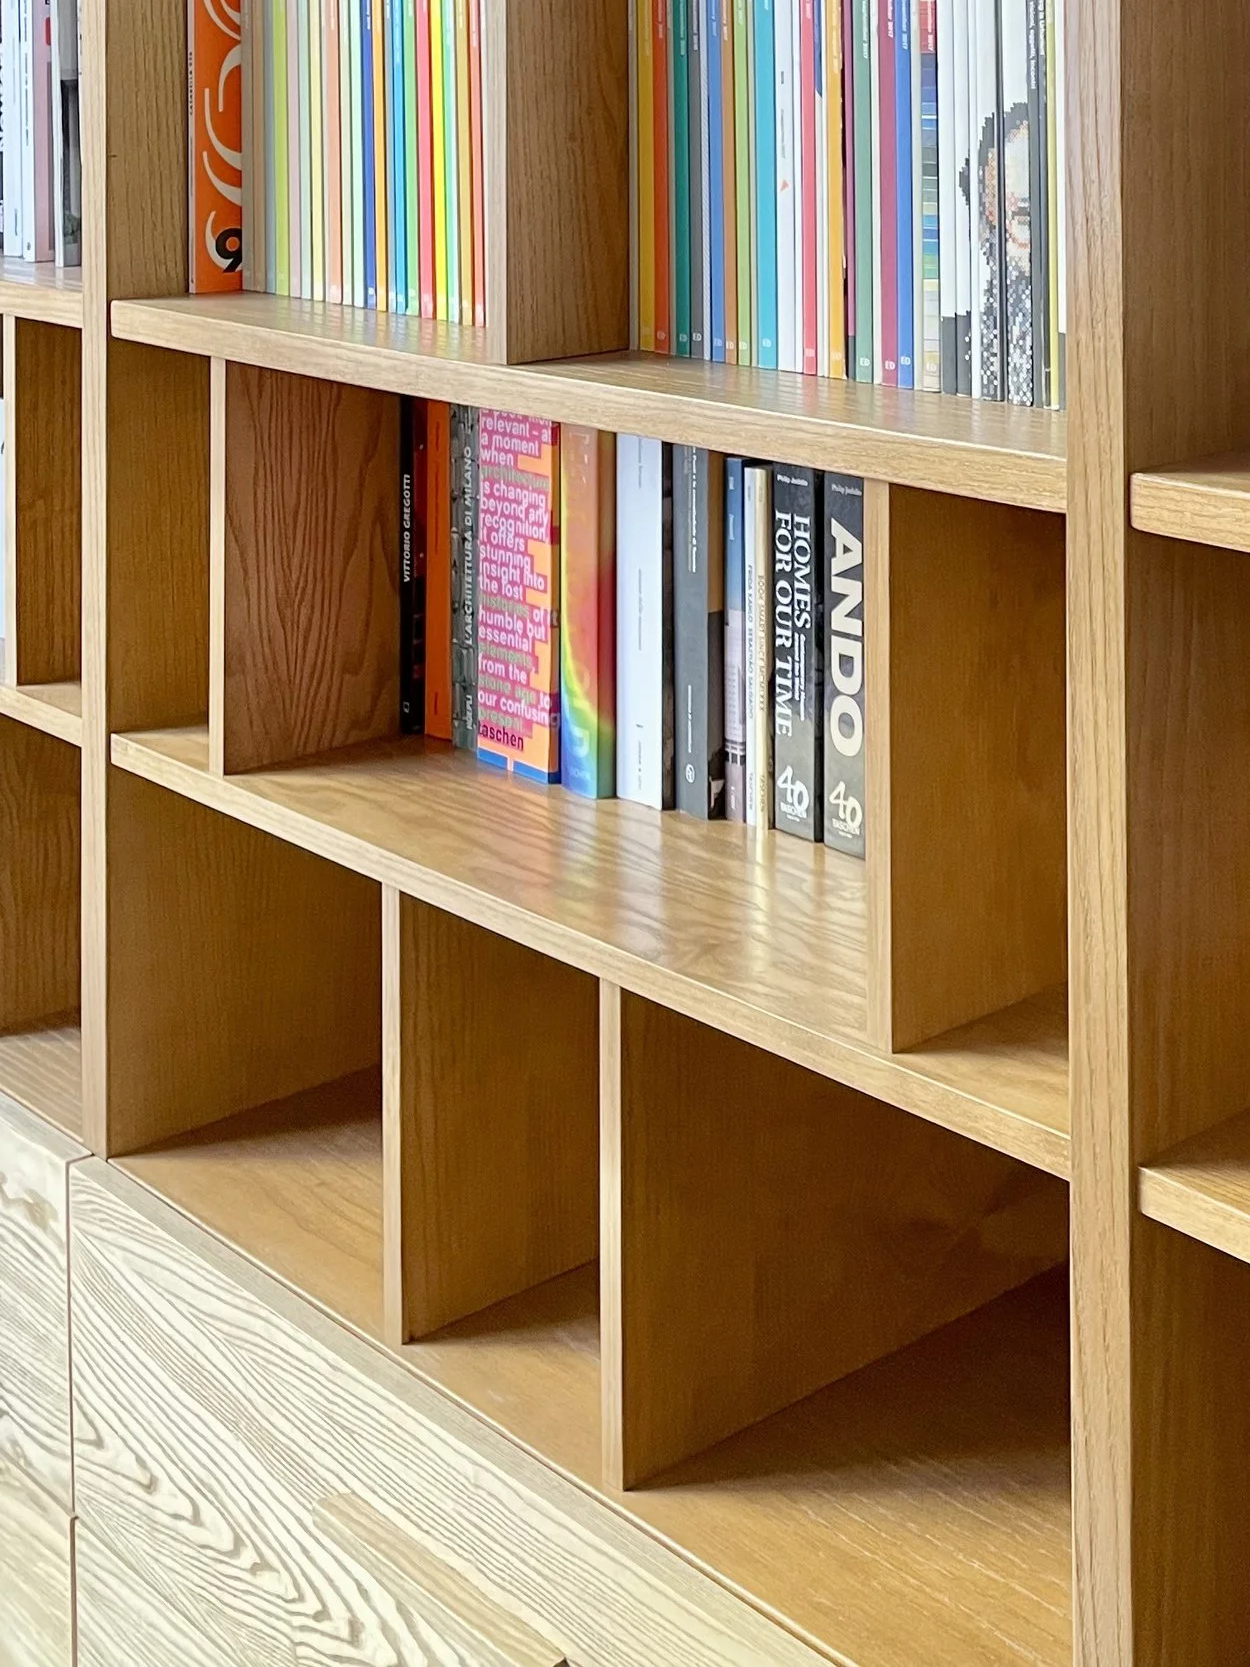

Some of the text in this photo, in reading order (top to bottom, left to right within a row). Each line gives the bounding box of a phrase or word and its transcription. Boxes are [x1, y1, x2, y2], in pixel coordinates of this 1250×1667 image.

[480, 413, 530, 439] relevant
[480, 446, 514, 466] when
[492, 436, 539, 457] moment
[481, 480, 546, 509] is changing
[480, 496, 549, 528] beyond any
[403, 473, 411, 583] VITTORIO GREGOTTI
[491, 529, 525, 552] offers
[462, 446, 474, 646] L'ARCHITETTURA DI MILANO
[480, 541, 531, 575] stunning
[480, 560, 545, 591] insight into
[794, 514, 811, 629] HOMES
[480, 576, 524, 601] the lost
[757, 575, 766, 602] BOOK
[480, 605, 546, 641] humble but
[533, 607, 546, 623] of
[757, 604, 766, 633] SMART
[775, 510, 793, 737] FOR OUR TIME
[479, 626, 533, 653] essential
[830, 517, 863, 757] ANDO
[479, 653, 505, 678] from
[508, 666, 528, 685] the
[465, 694, 474, 730] HOEPLI
[479, 691, 498, 709] our
[479, 721, 525, 752] taschen
[777, 765, 810, 814] 40
[830, 781, 863, 831] 40
